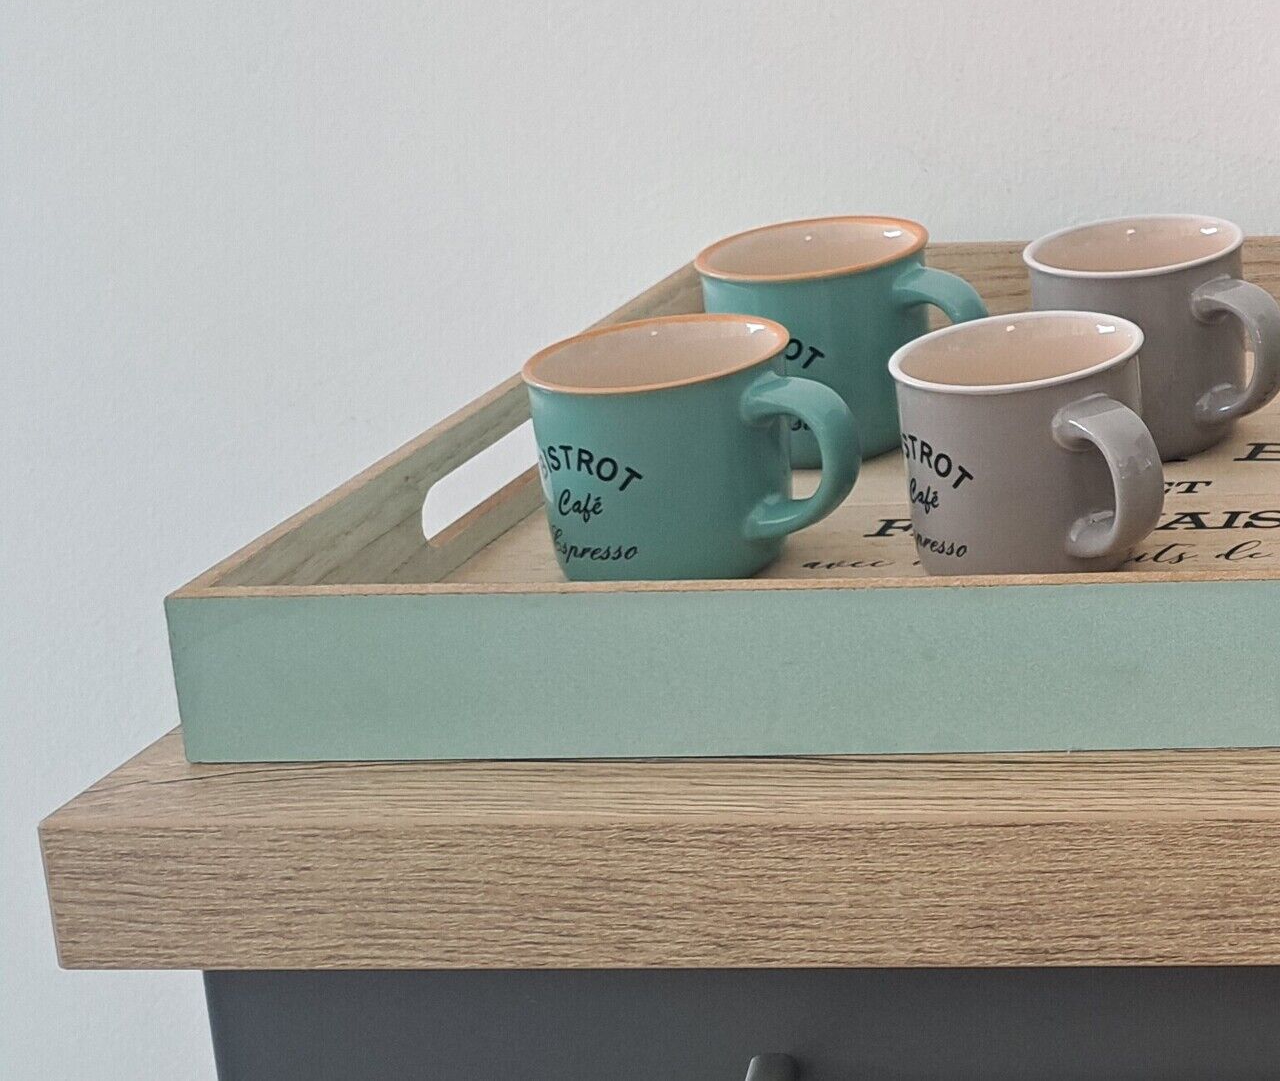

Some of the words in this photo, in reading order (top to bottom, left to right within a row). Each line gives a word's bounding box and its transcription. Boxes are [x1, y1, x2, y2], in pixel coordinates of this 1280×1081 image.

[557, 488, 604, 524] Café
[909, 477, 939, 515] Café
[916, 532, 968, 558] presso
[1214, 539, 1272, 561] de
